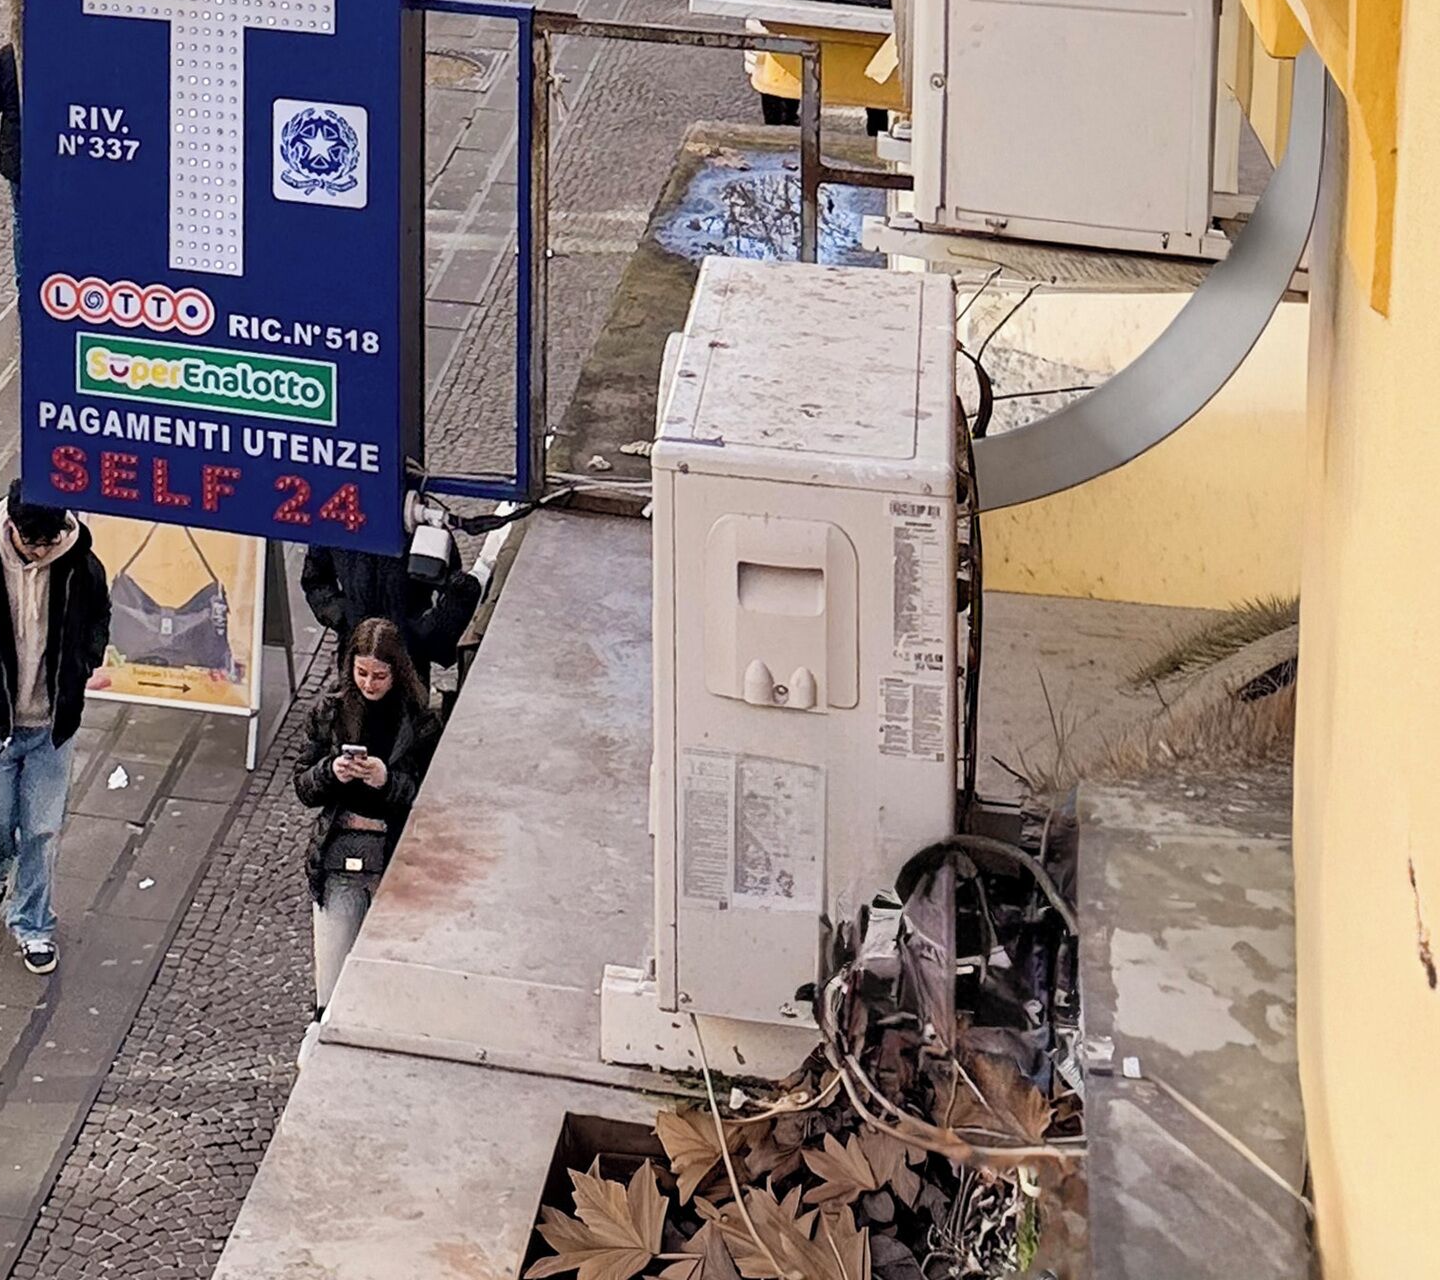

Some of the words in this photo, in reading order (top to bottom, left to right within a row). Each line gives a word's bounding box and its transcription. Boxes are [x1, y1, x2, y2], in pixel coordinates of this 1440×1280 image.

[68, 104, 129, 134] RIV.
[45, 277, 211, 332] LOTTO
[86, 347, 324, 408] SuperEnalotto
[38, 400, 232, 453] PAGAMENTI
[242, 426, 380, 473] UTENZE
[49, 444, 242, 513] SELF
[272, 474, 367, 533] 24
